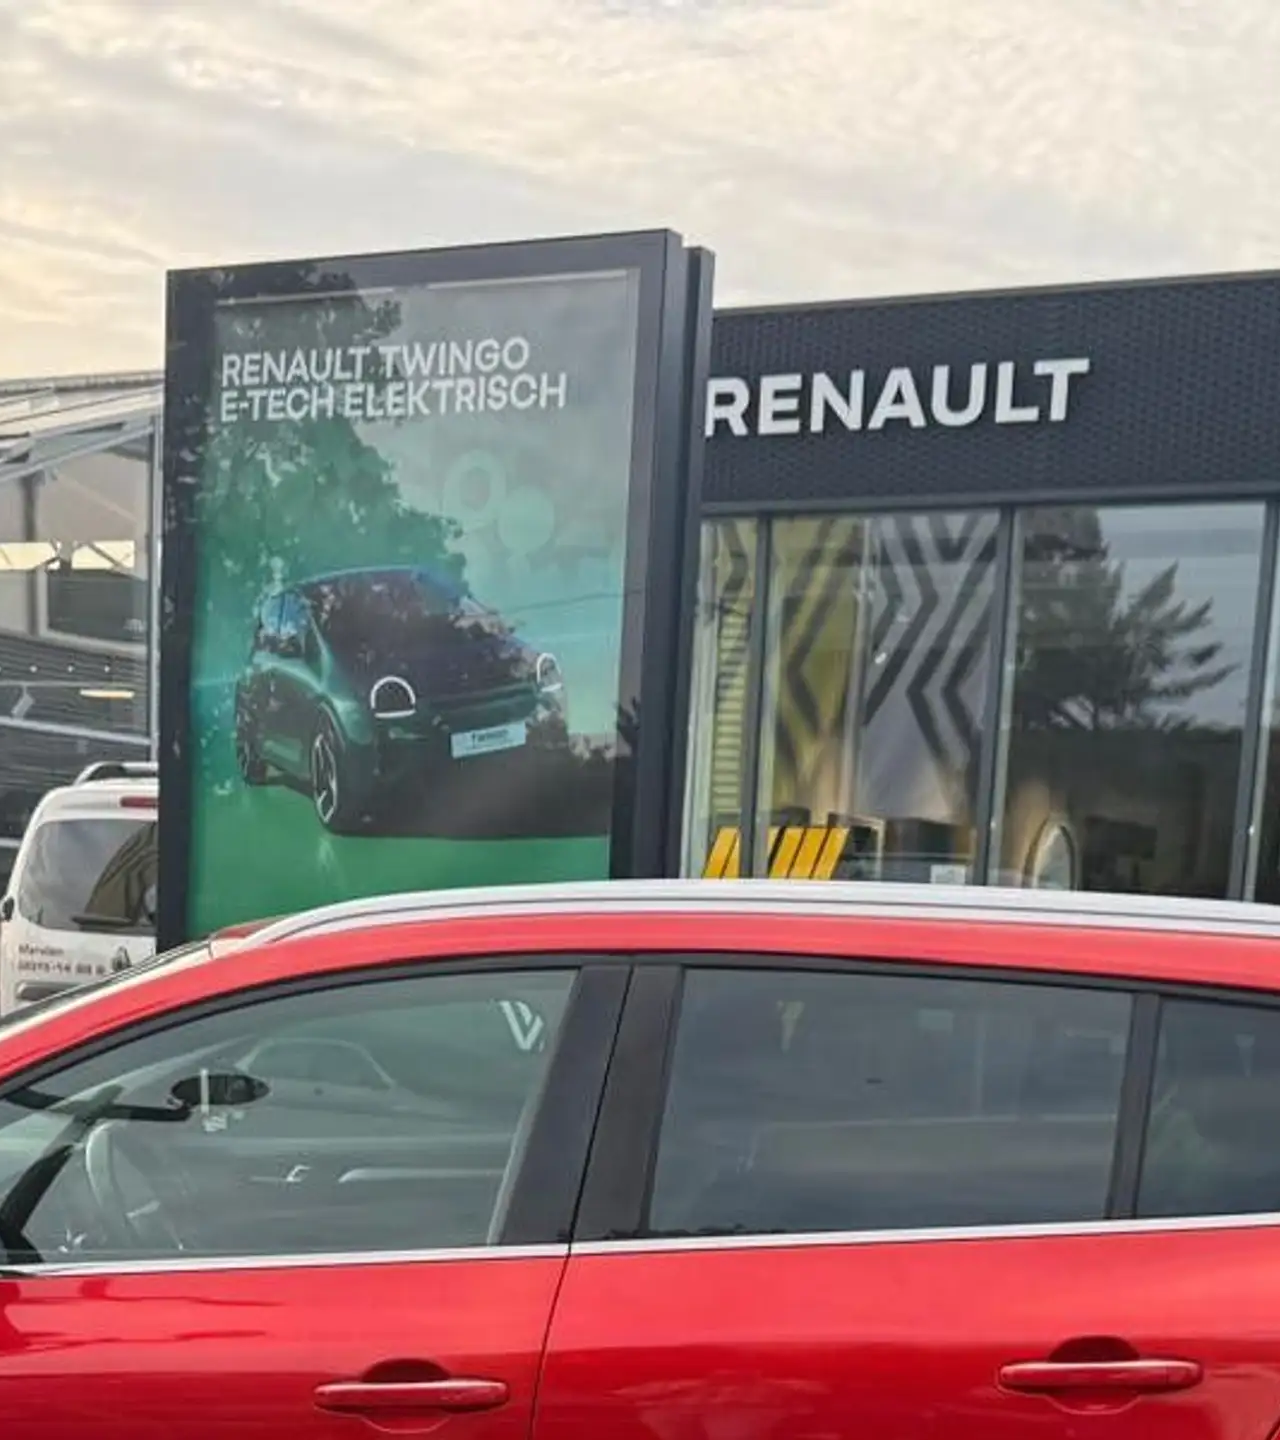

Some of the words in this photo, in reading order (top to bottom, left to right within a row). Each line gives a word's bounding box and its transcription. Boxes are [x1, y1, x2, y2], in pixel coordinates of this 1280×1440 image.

[222, 346, 370, 387] RENAULT
[379, 336, 530, 379] TWINGO
[220, 386, 335, 422] E-TECH
[344, 373, 568, 418] ELEKTRISCH
[704, 358, 1090, 437] RENAULT
